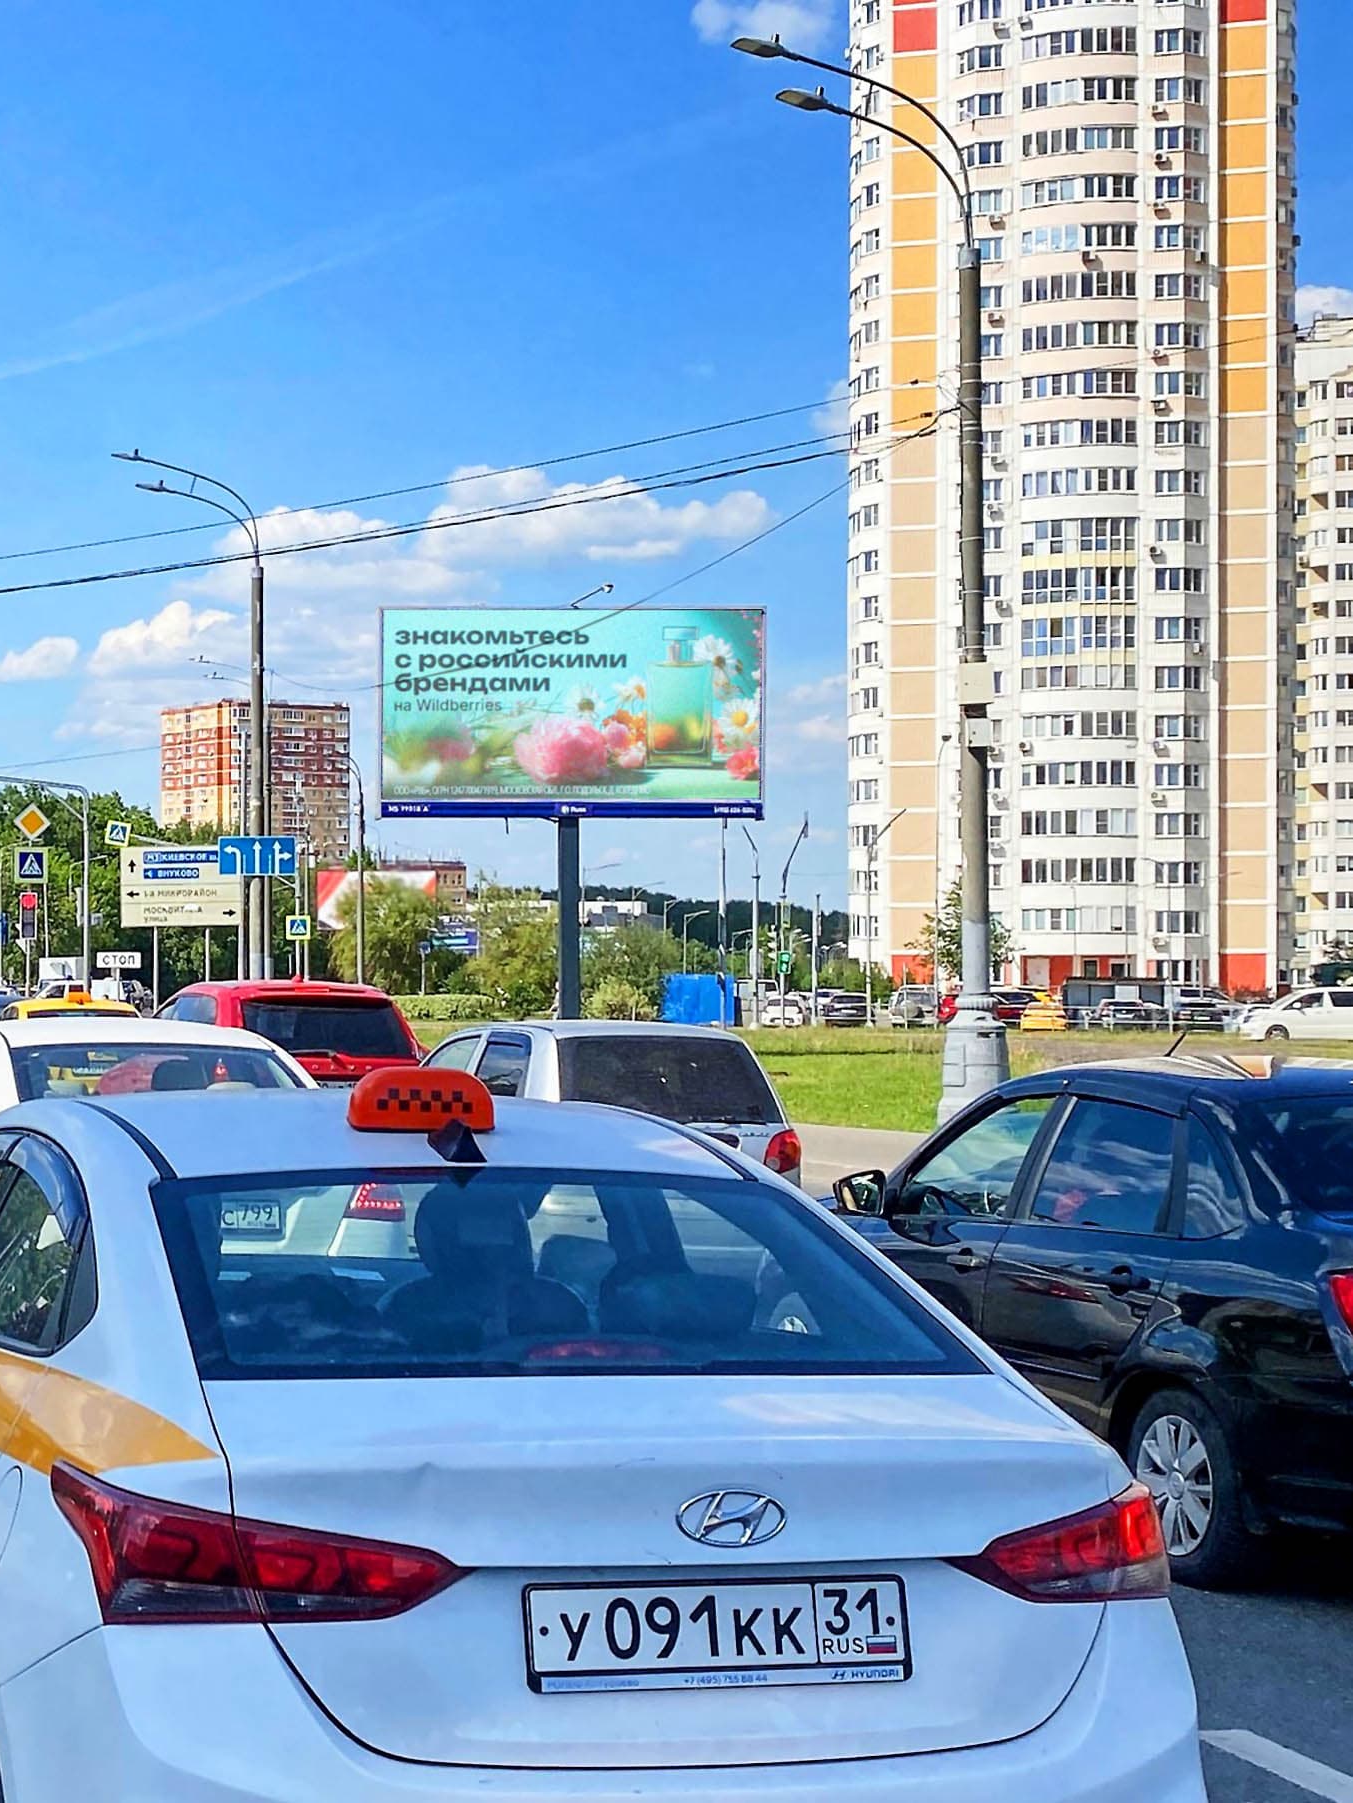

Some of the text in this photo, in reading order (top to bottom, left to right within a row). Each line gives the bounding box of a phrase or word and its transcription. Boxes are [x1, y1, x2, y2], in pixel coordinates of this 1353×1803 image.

[394, 629, 591, 646] знакомьтесь
[394, 648, 628, 672] с российскими
[394, 672, 551, 695] брендами
[394, 698, 503, 712] на Wildberries
[157, 869, 199, 878] ВНУКОВО
[102, 954, 135, 966] СТОП
[822, 1587, 881, 1636] 31
[822, 1637, 865, 1656] RUS
[696, 1675, 722, 1687] (495)
[851, 1668, 900, 1680] HYUNDAI
